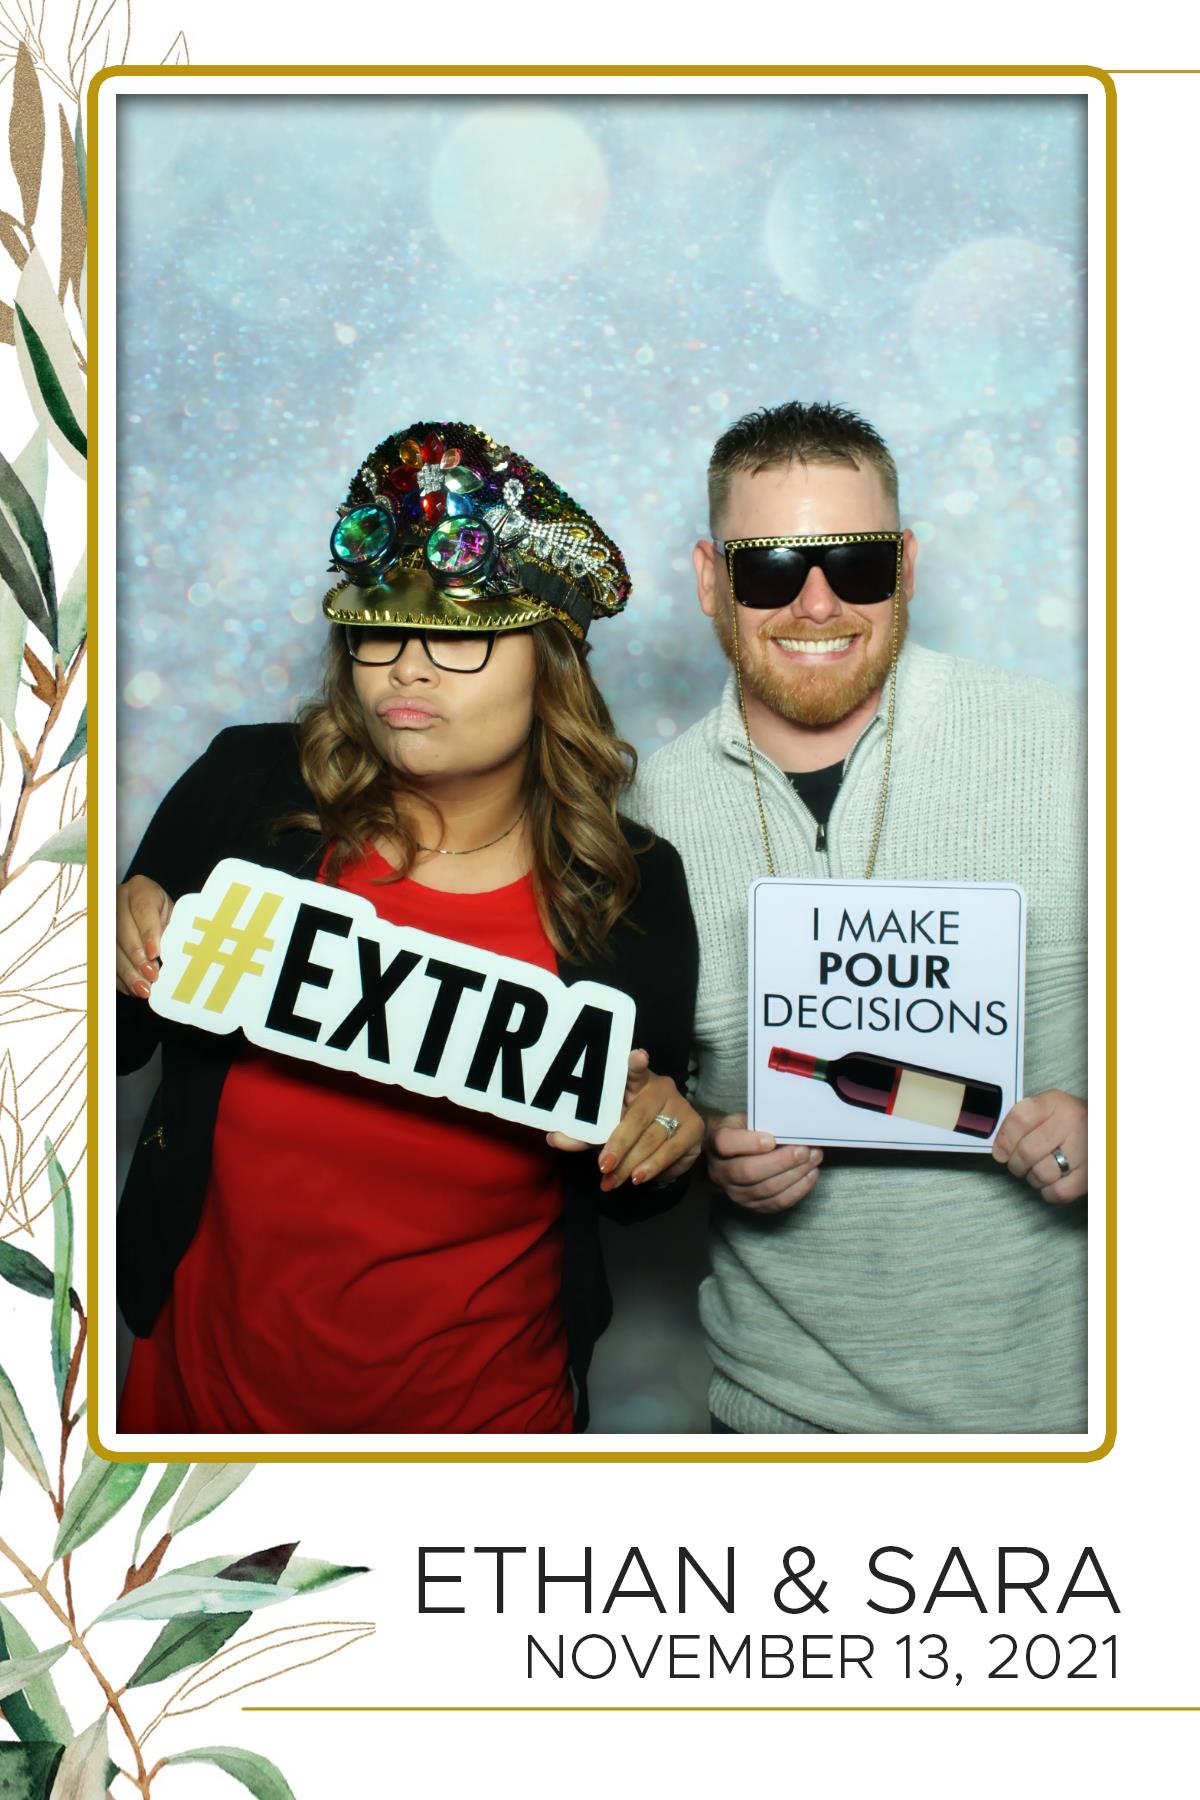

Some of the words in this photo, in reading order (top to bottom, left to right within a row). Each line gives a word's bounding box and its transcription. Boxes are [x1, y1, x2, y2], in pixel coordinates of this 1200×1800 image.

[813, 907, 819, 941] I
[837, 908, 960, 945] MAKE
[819, 951, 951, 989] POUR
[171, 882, 614, 1125] #EXTRA
[763, 993, 1008, 1036] DECISIONS
